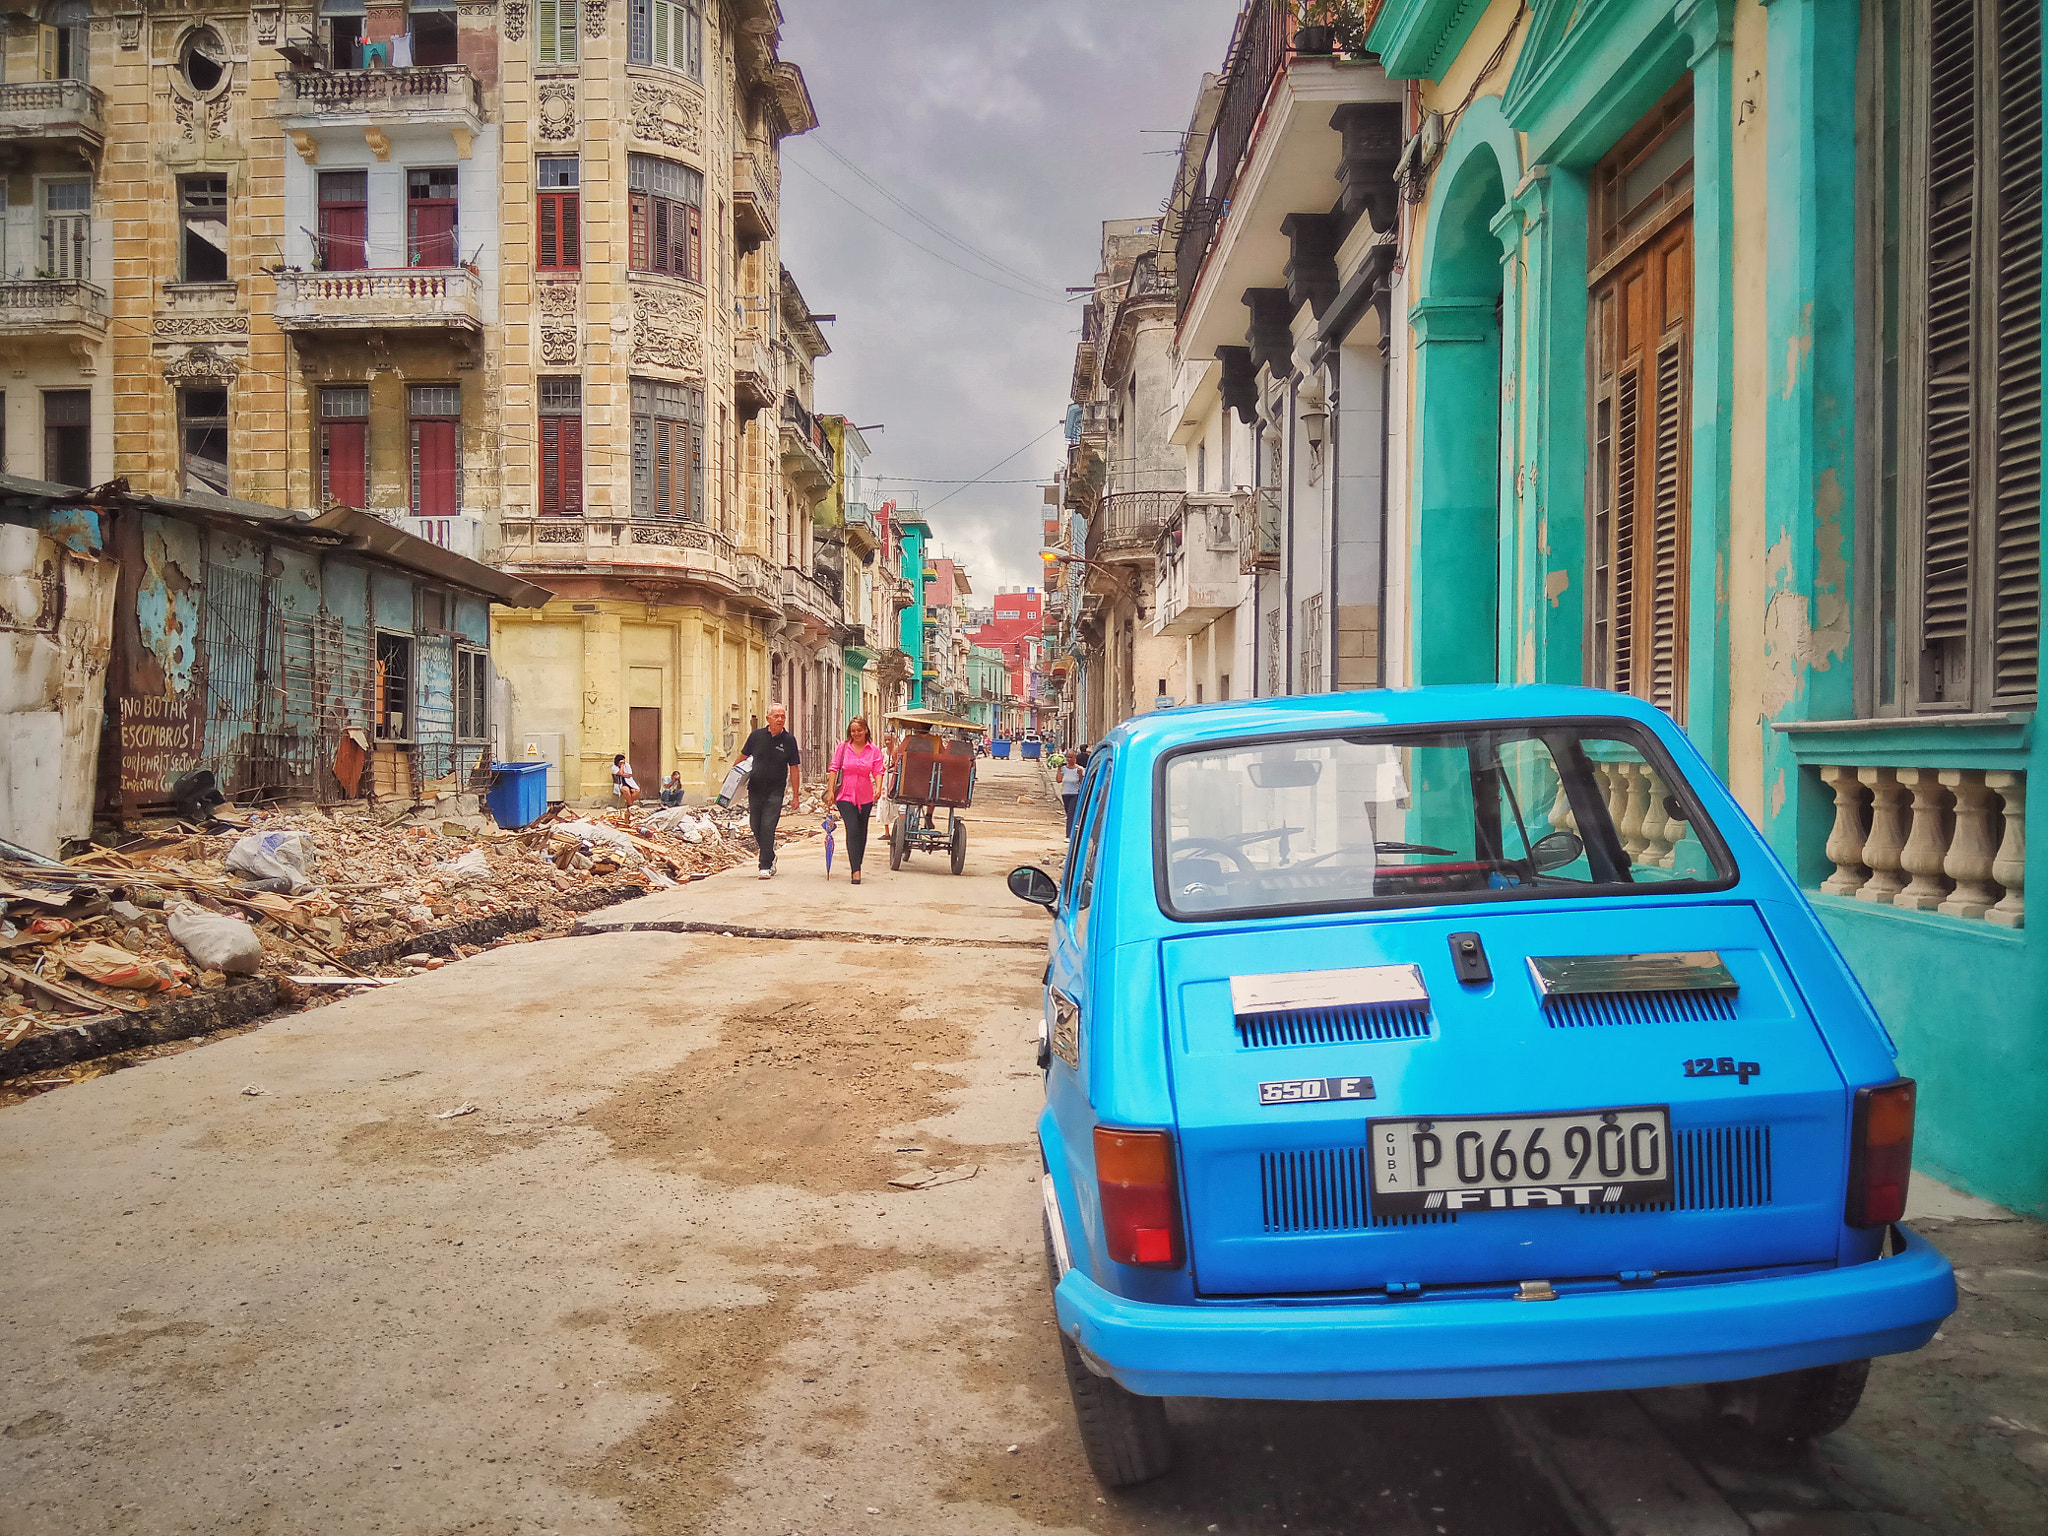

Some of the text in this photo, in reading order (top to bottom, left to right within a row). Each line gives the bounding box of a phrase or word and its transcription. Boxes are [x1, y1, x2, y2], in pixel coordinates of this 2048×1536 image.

[144, 695, 188, 720] BOTAR
[1682, 1056, 1760, 1085] 126p
[1262, 1078, 1361, 1101] 650 E
[1385, 1132, 1398, 1183] CUBA
[1446, 1185, 1603, 1209] FIAT
